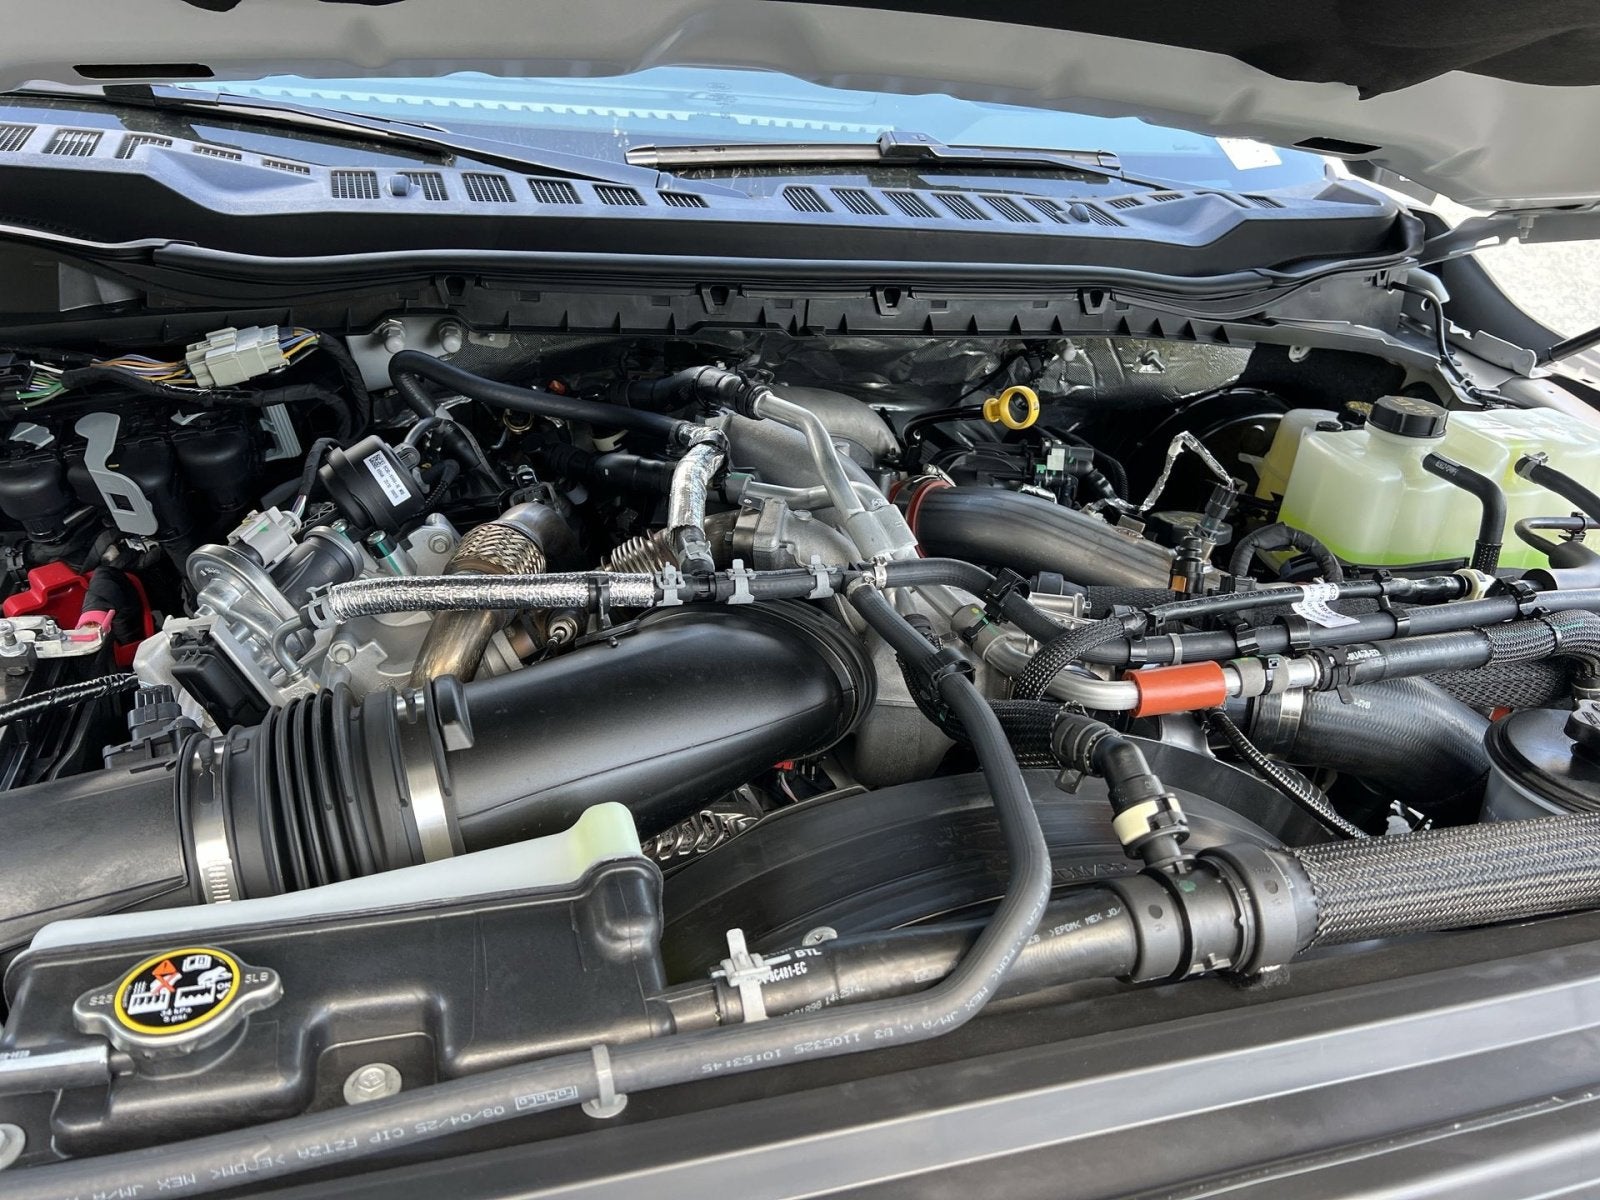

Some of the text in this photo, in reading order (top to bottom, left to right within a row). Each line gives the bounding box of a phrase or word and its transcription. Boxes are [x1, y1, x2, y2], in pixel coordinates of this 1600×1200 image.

[1084, 912, 1103, 926] MEX
[794, 947, 822, 958] BTL
[964, 986, 989, 1011] MEX
[794, 1032, 861, 1055] 1105325
[702, 1050, 782, 1074] 10:53:45
[415, 1105, 505, 1134] 08/04/25
[157, 1172, 196, 1191] MEX
